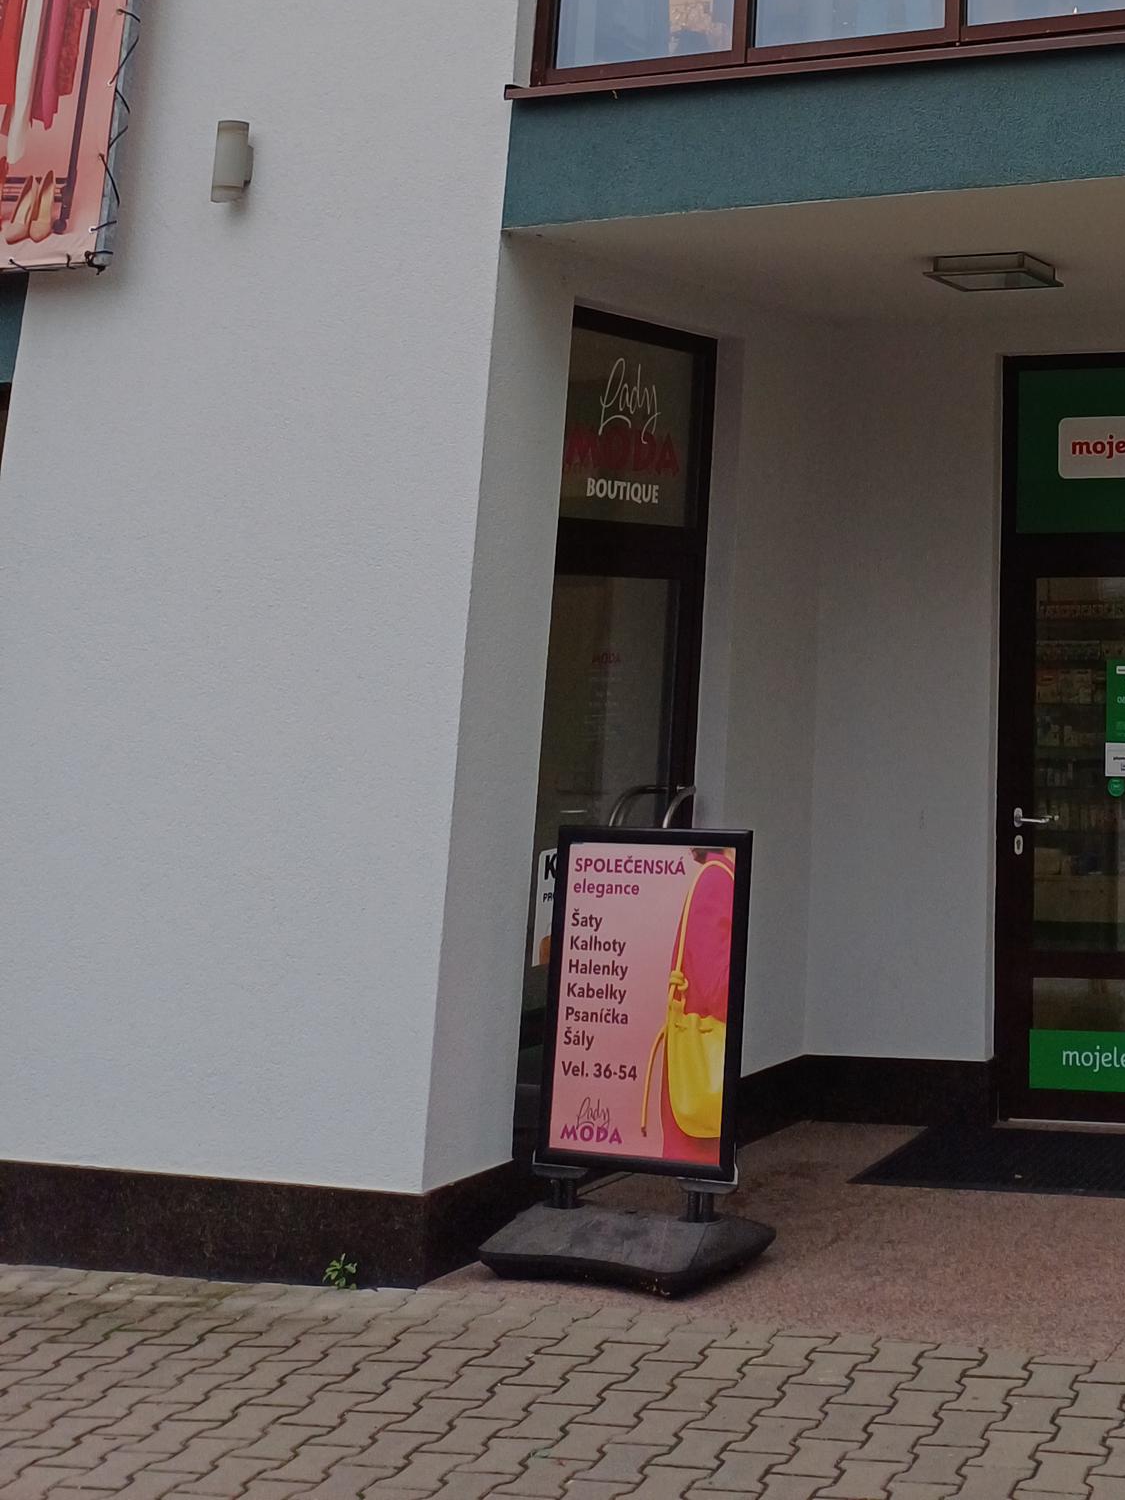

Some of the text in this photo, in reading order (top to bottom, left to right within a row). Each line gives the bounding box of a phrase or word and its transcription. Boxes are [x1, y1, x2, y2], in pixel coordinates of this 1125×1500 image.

[598, 356, 661, 444] Lady
[586, 477, 659, 504] BOUTIQUE
[574, 855, 686, 875] SPOLEČENSKÁ
[573, 878, 640, 898] elegance
[571, 908, 602, 932] Šaty
[569, 935, 626, 956] Kalhoty
[568, 959, 628, 981] Halenky
[566, 982, 627, 1004] Kabelky
[565, 1006, 629, 1024] Psaníčka
[563, 1027, 594, 1051] Šály
[561, 1061, 638, 1081] Vel. 36-54
[576, 1096, 610, 1130] Lady
[560, 1124, 622, 1144] MODA
